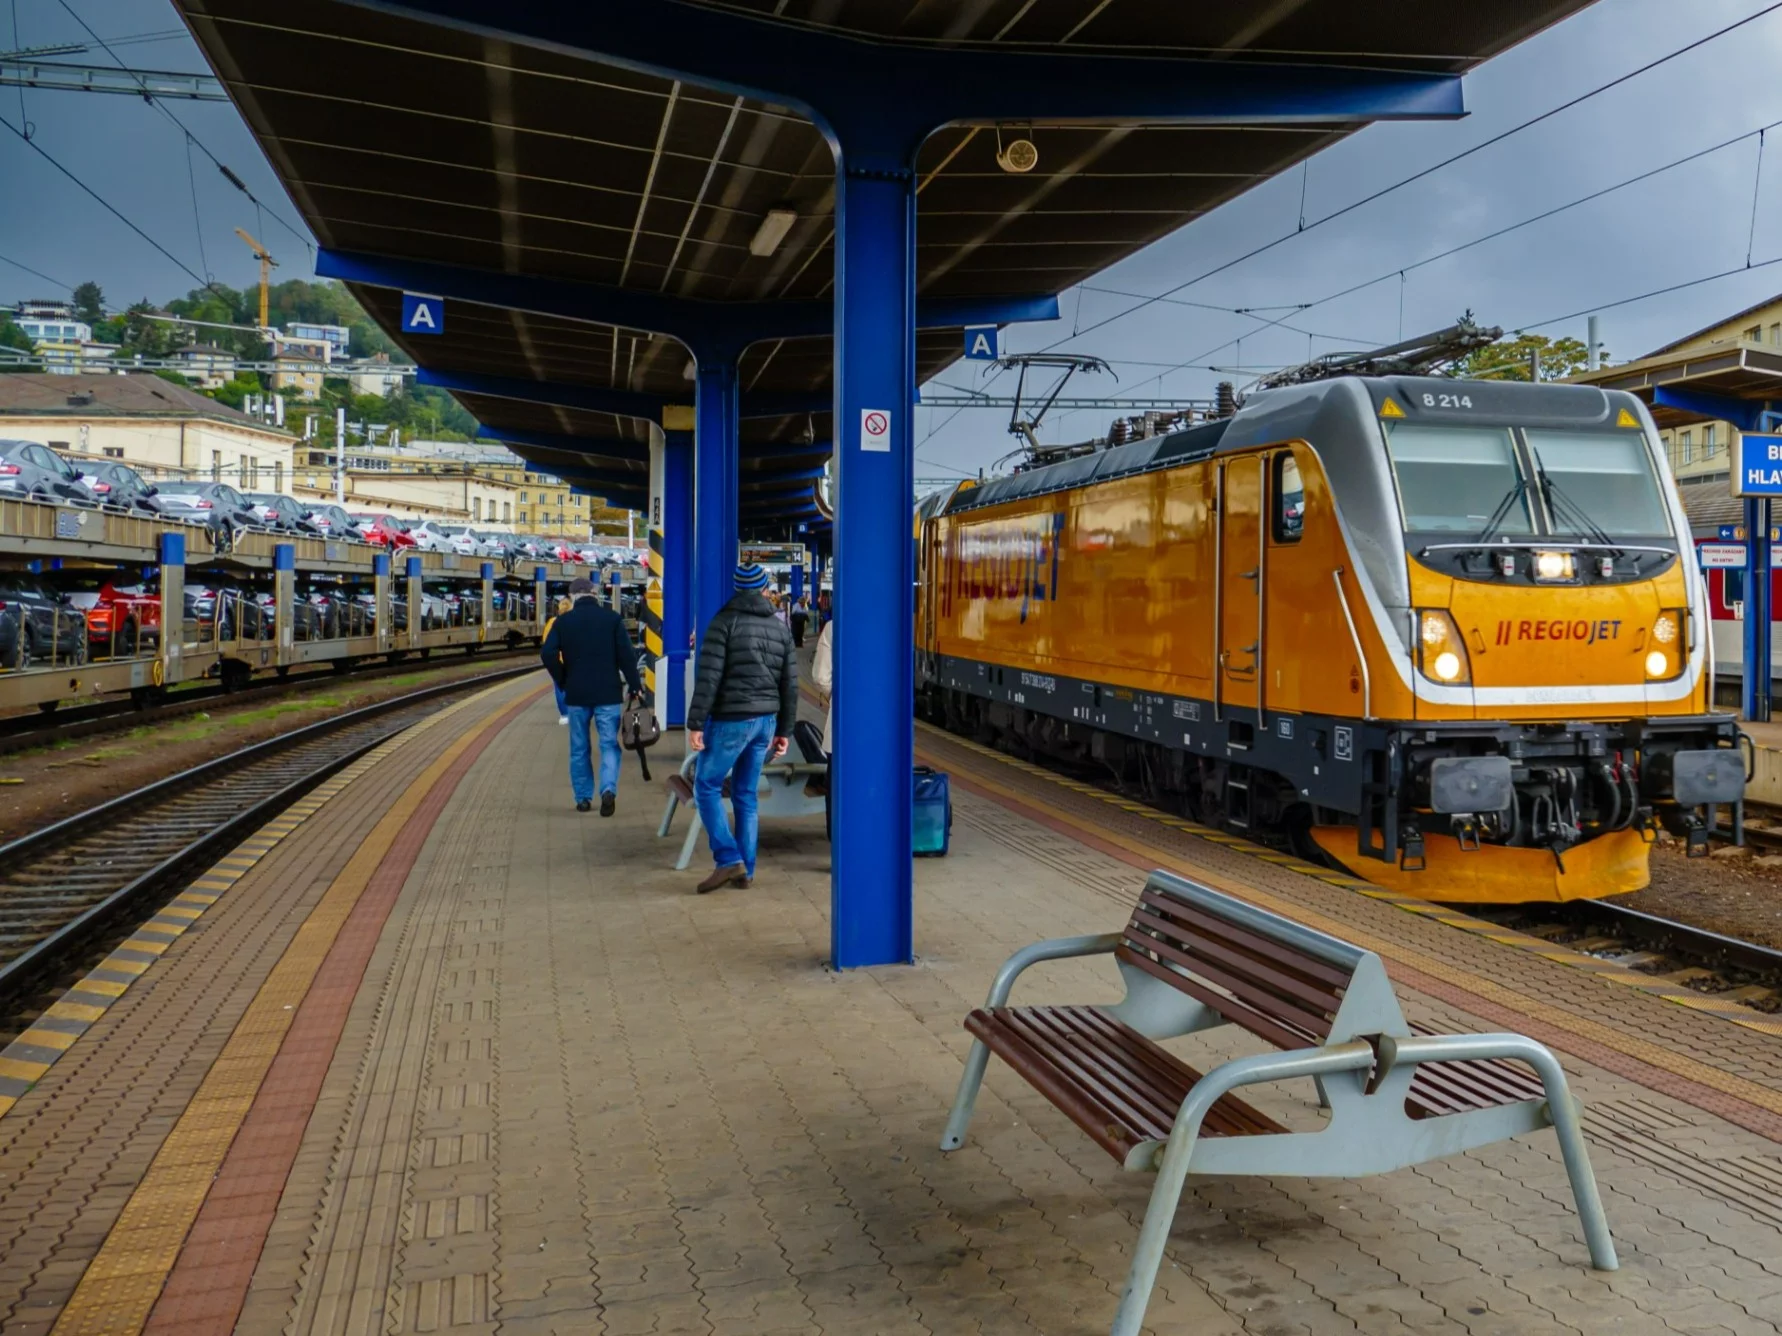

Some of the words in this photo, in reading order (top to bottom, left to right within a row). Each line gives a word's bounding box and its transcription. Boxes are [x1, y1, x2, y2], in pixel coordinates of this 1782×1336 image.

[410, 303, 435, 328] A
[972, 333, 992, 355] A
[1422, 393, 1435, 407] 8
[1438, 394, 1473, 408] 214
[1767, 444, 1782, 460] B
[793, 552, 801, 561] 14
[1517, 620, 1622, 645] REGIOJET
